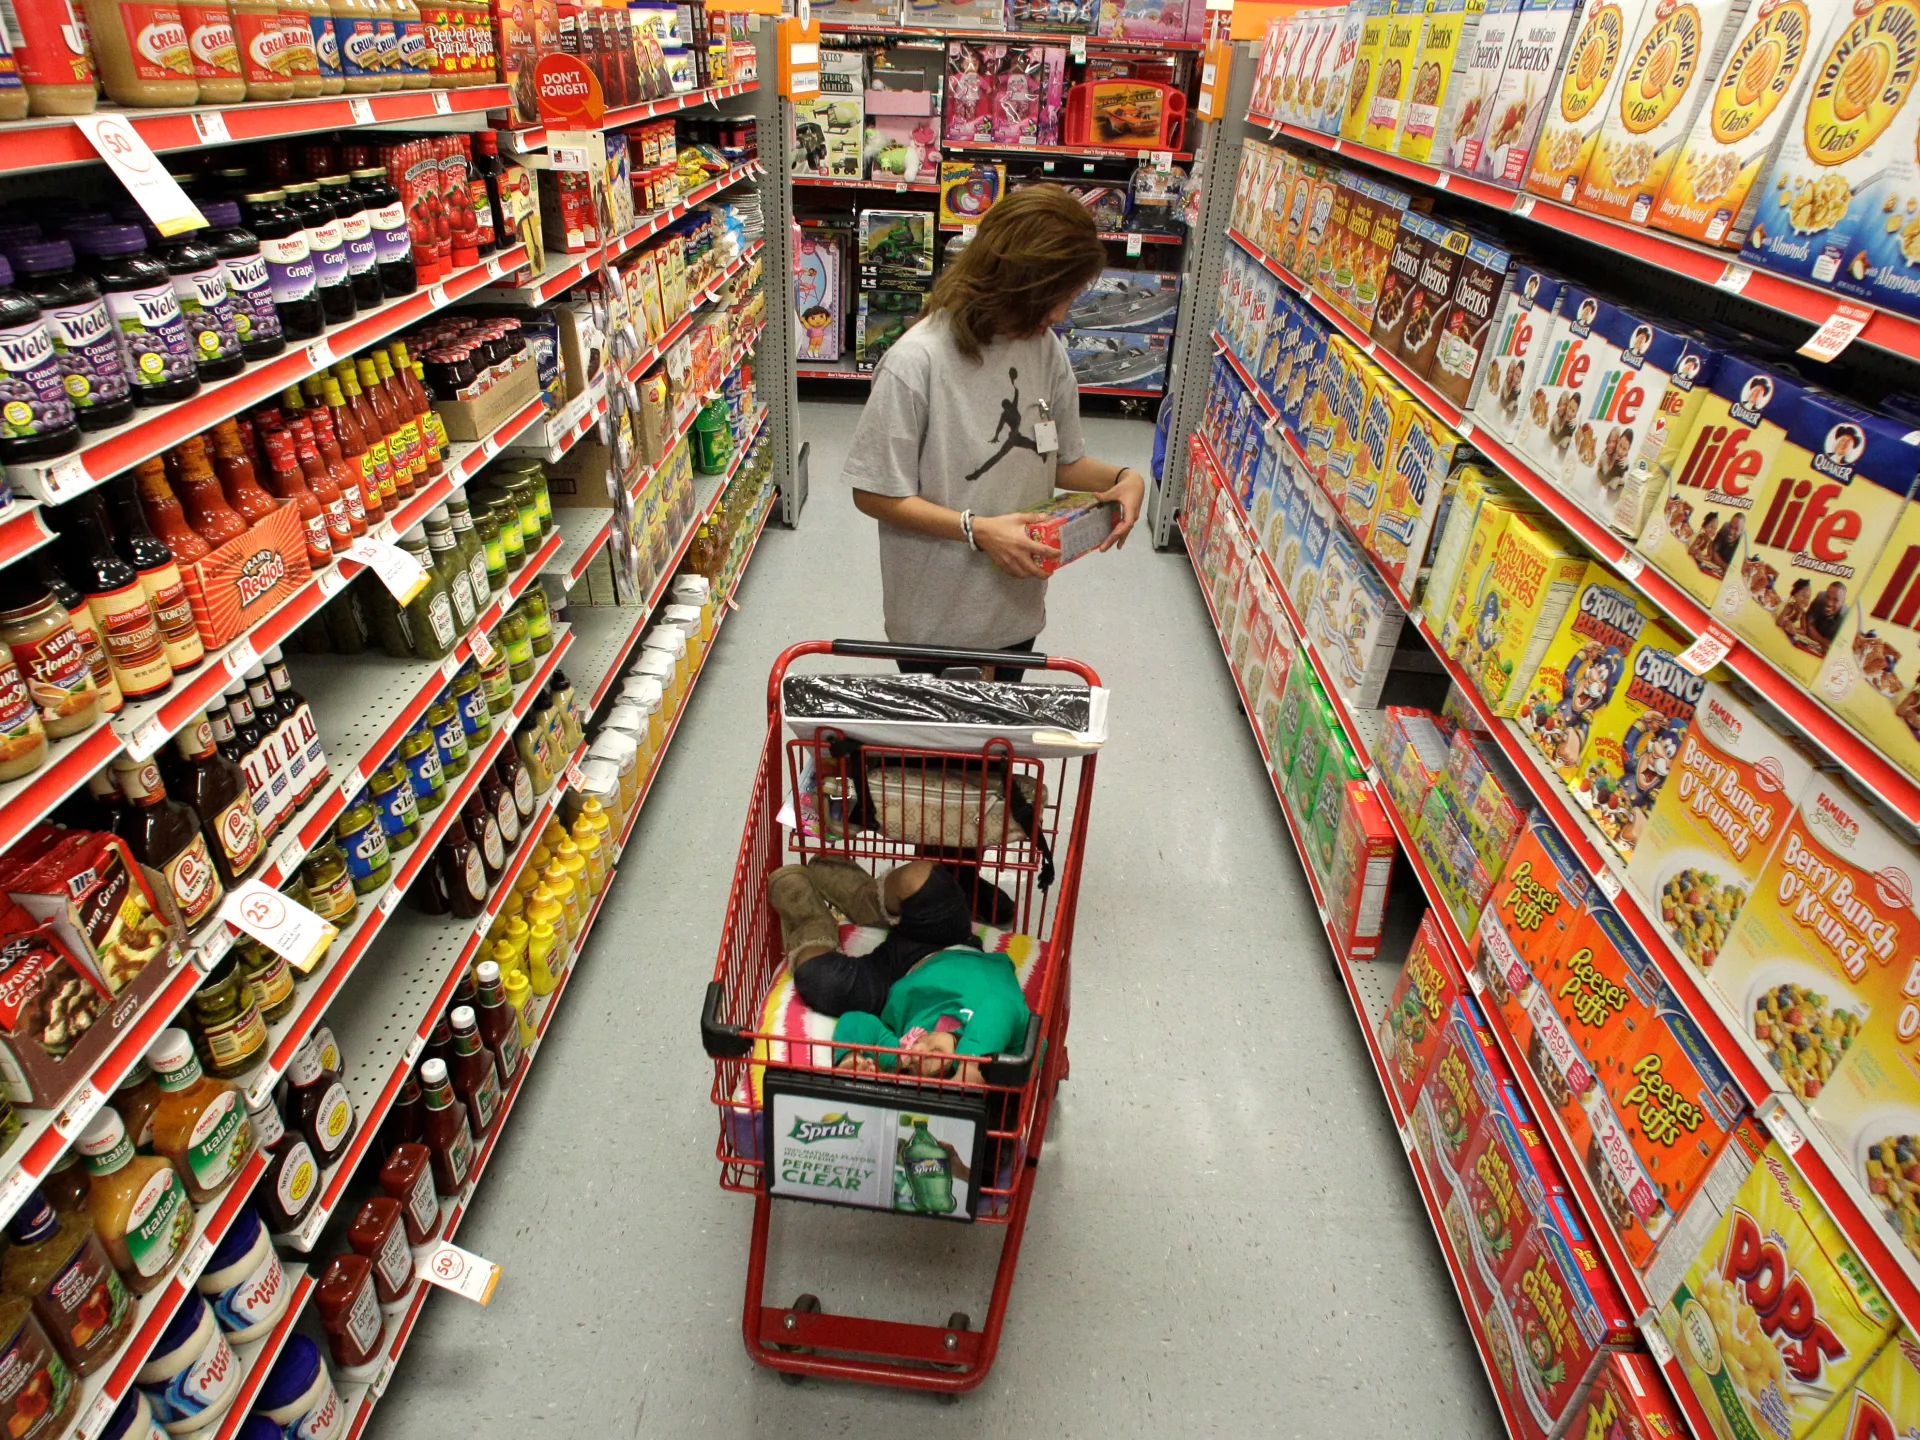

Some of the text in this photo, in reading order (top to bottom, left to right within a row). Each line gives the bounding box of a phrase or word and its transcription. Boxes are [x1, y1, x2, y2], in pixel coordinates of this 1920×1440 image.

[1425, 24, 1451, 49] Cheerios
[1568, 11, 1623, 81] HONEY BUNCHES
[1629, 11, 1696, 89] HONEY BUNCHES
[1724, 8, 1804, 93] HONEY BUNCHES
[1469, 41, 1503, 70] Cheerios
[1508, 41, 1553, 71] Cheerios
[1816, 4, 1920, 107] HONEY BUNCHES
[541, 84, 588, 97] FORGET!
[543, 72, 581, 84] DON'T
[1567, 95, 1588, 112] Oats
[1631, 103, 1658, 123] Oats
[1722, 111, 1754, 132] Oats
[1817, 125, 1860, 151] Oats
[1680, 204, 1710, 225] Roasted
[351, 240, 375, 255] Grape
[386, 230, 409, 243] Grape
[1371, 218, 1395, 251] Cheerios
[1771, 234, 1812, 263] Almonds
[286, 265, 315, 281] Grape
[323, 251, 347, 267] Grape
[1391, 241, 1421, 279] Cheerios
[1418, 256, 1451, 297] Cheerios
[1454, 274, 1492, 319] Cheerios
[1838, 304, 1852, 314] NEW
[1500, 312, 1532, 357] life
[1823, 324, 1851, 341] WHAT'S
[1833, 320, 1853, 331] LOOK
[93, 351, 118, 366] Grape
[1814, 336, 1845, 352] NEW!
[36, 374, 62, 391] Grape
[1542, 340, 1591, 389] life
[1588, 369, 1645, 424] life
[1659, 390, 1685, 413] life
[1729, 402, 1761, 424] QUAKER
[1677, 424, 1764, 496] life
[1814, 456, 1853, 482] QUAKER
[1704, 488, 1754, 511] Cinnamon
[1754, 476, 1863, 563] life
[1500, 531, 1547, 585] CRUNCH
[1791, 551, 1855, 579] Cinnamon
[109, 611, 133, 626] Family
[1580, 583, 1649, 639] CRUNCH
[46, 629, 77, 655] HEINZ
[1573, 611, 1636, 657] BERRIES
[1702, 711, 1741, 744] gourmet
[1709, 699, 1743, 732] FAMILY
[1682, 736, 1726, 786] Berry
[1721, 768, 1773, 838] Bunch
[1679, 771, 1751, 858] O'Krunch
[1808, 808, 1857, 850] gourmet
[1816, 793, 1860, 836] FAMILY
[98, 868, 126, 906] Gravy
[1511, 861, 1561, 915] Reese's
[1782, 831, 1839, 895] Berry
[1829, 875, 1897, 960] Bunch
[246, 901, 269, 923] 25
[1502, 888, 1544, 931] Puffs
[1777, 870, 1868, 978] O'Krunch
[4, 964, 47, 1008] Gravy
[1568, 948, 1630, 1011] Reese's
[112, 995, 140, 1029] Gravy
[1559, 978, 1610, 1028] Puffs
[1633, 1052, 1704, 1132] Reese's
[201, 1111, 239, 1157] Italian
[796, 1121, 856, 1141] Sprite
[1621, 1085, 1681, 1147] Puffs
[782, 1158, 875, 1180] PERFECTLY
[1612, 1136, 1636, 1178] BOX
[781, 1169, 862, 1191] CLEAR
[1476, 1153, 1510, 1223] Charms
[1764, 1155, 1801, 1211] Kellogg's
[141, 1190, 178, 1241] Italian
[58, 1273, 86, 1304] Zesty
[1720, 1205, 1851, 1383] POPS
[1522, 1269, 1565, 1353] Charms
[1684, 1309, 1714, 1362] FIBER
